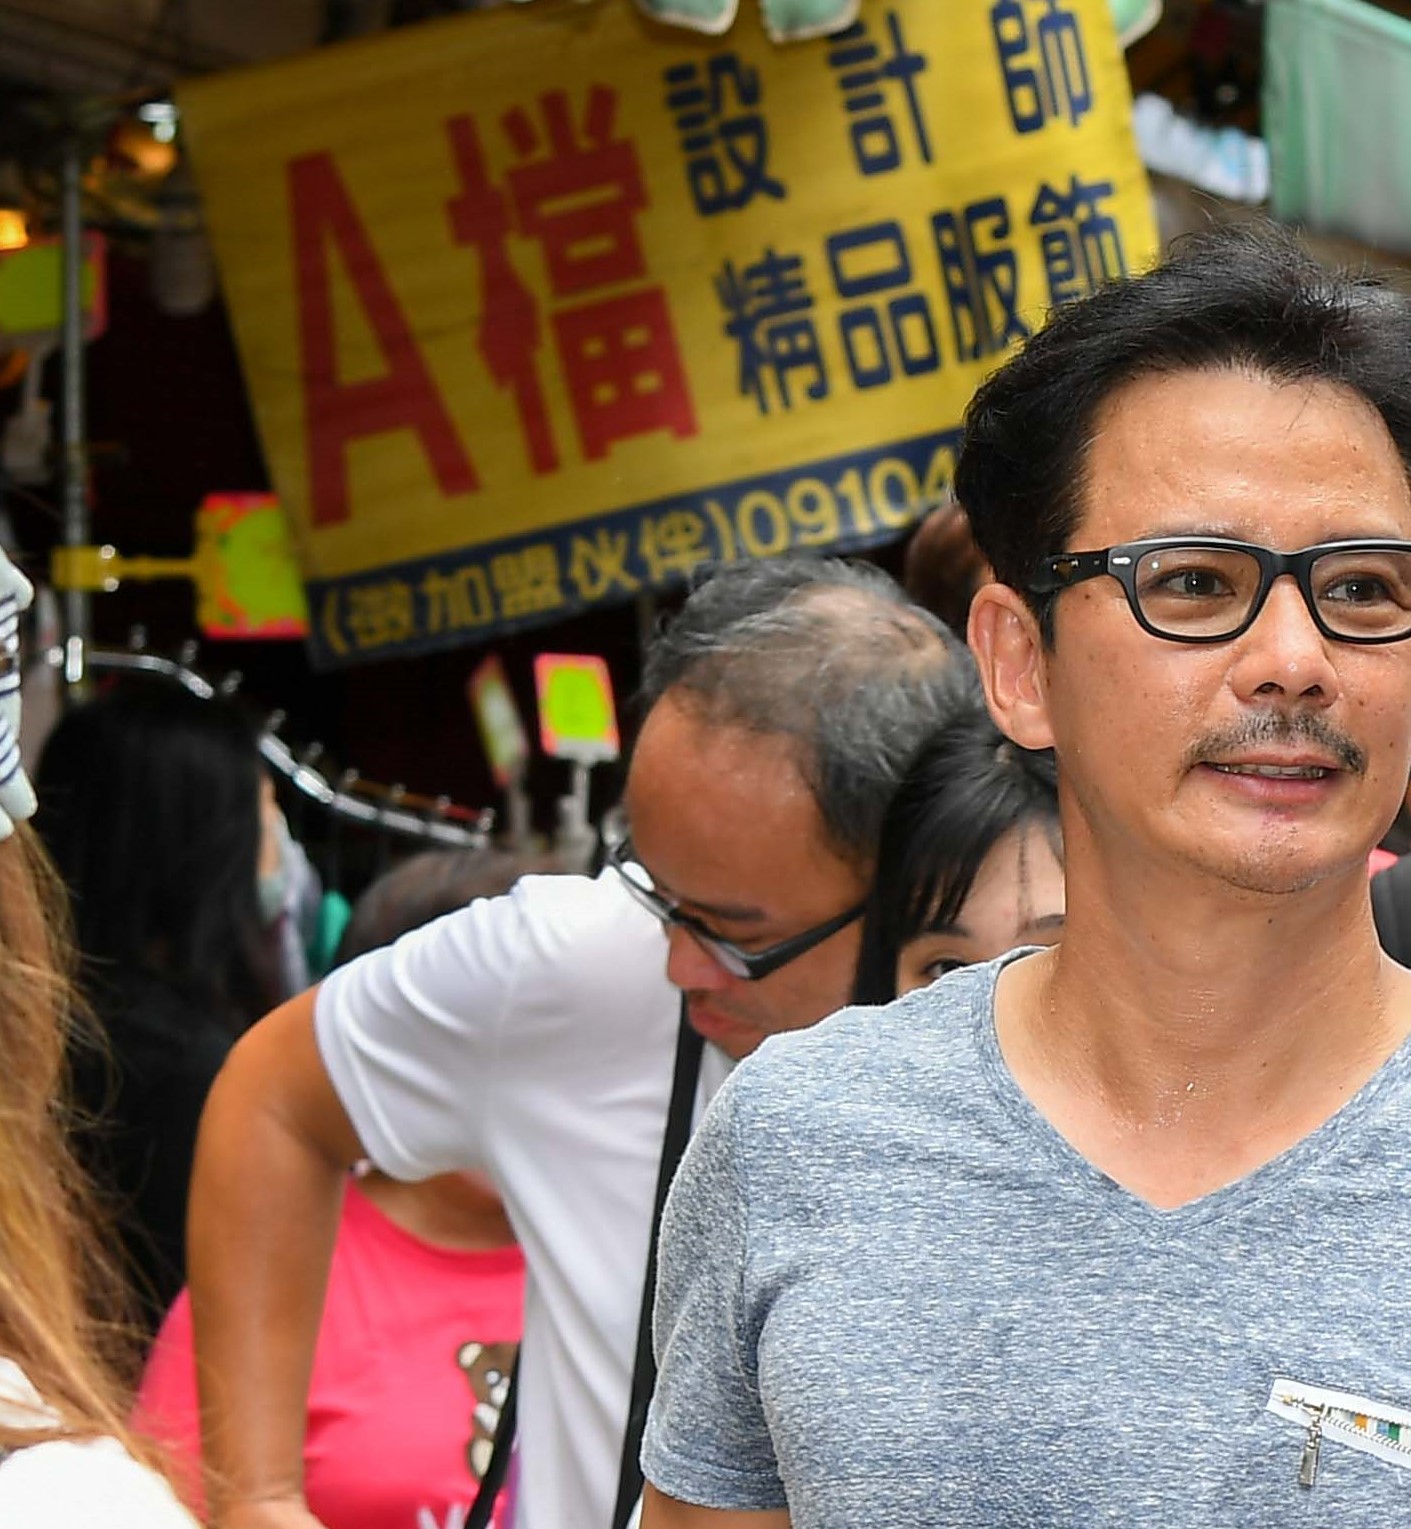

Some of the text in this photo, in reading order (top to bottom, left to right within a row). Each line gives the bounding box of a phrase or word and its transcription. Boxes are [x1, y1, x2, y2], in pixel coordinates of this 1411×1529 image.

[662, 0, 1093, 217] 設計師
[286, 84, 702, 529] A檔
[713, 176, 1129, 415] 精品服飾
